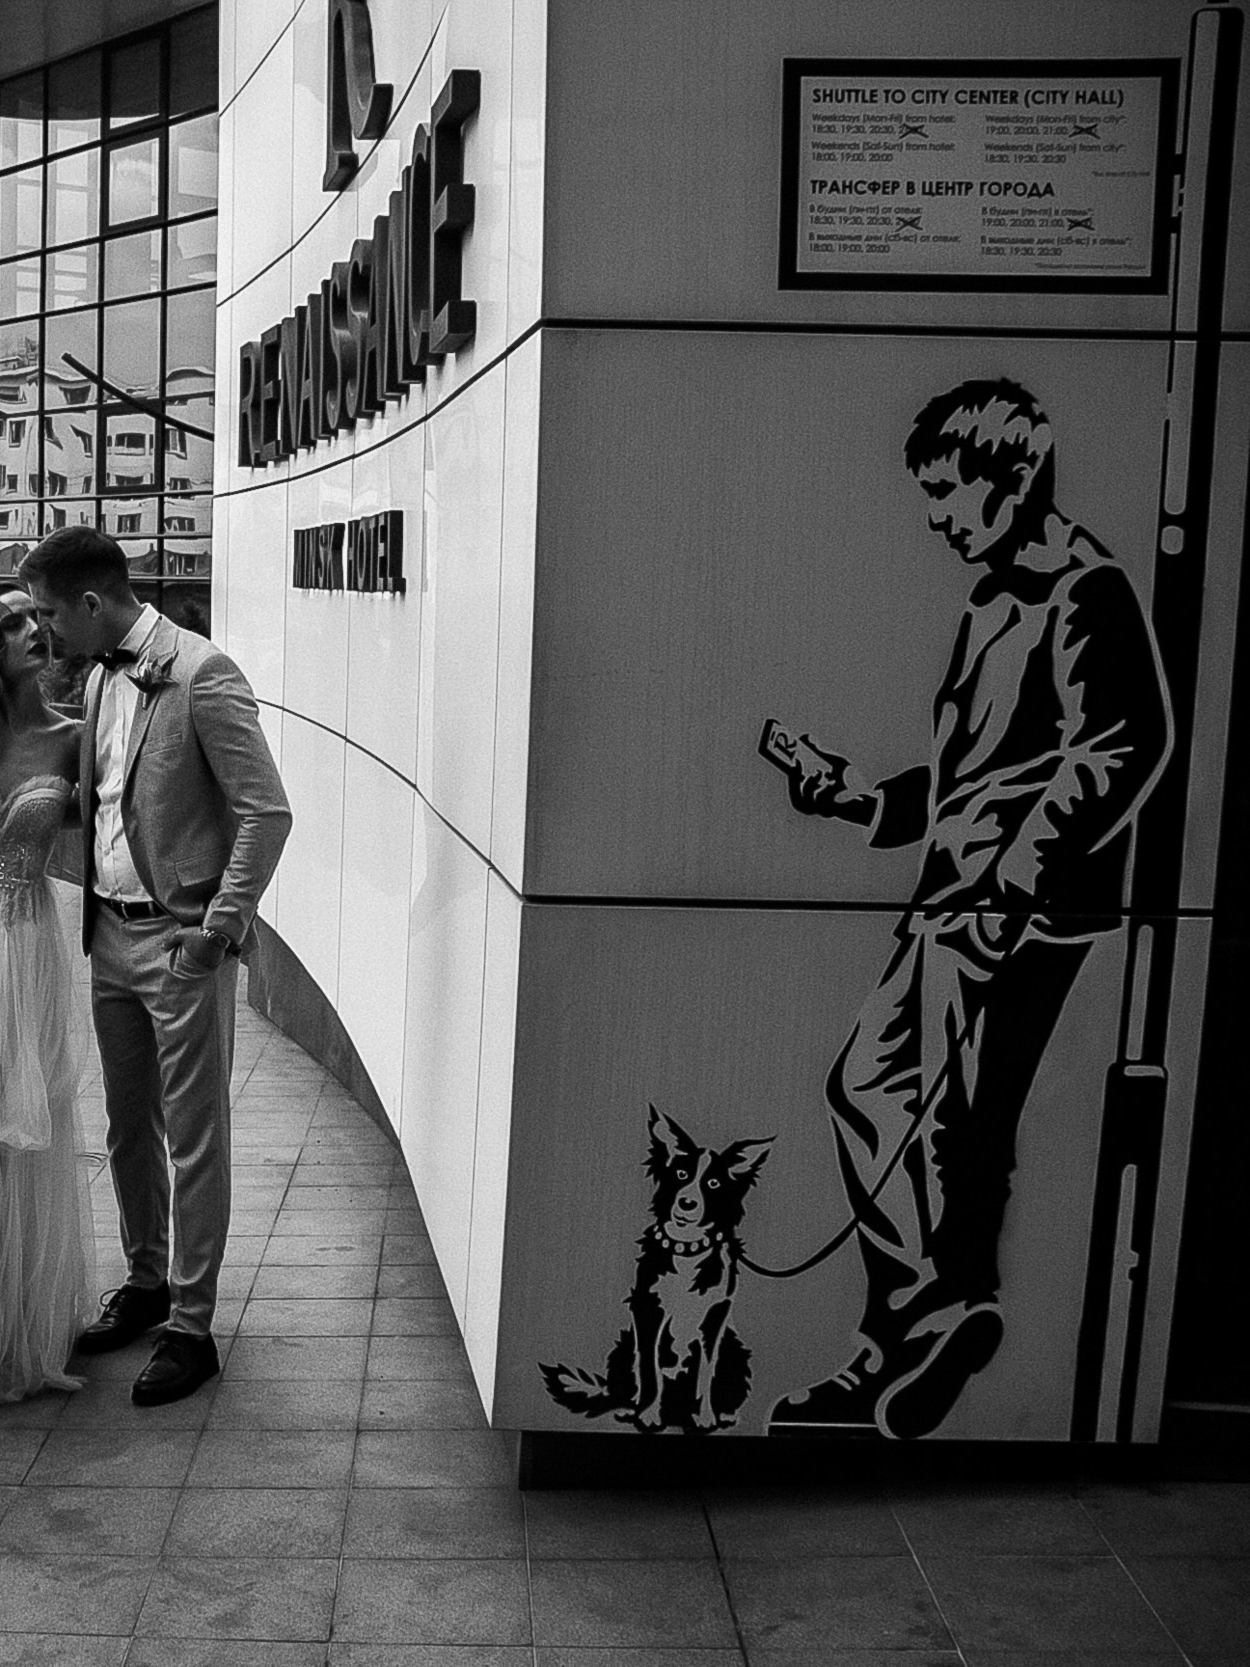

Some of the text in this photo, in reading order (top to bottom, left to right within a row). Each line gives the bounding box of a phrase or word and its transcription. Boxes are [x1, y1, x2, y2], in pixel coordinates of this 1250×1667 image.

[812, 89, 1124, 108] SHUTTLE TO CITY CENTER (CITY HALL)
[812, 114, 860, 123] Weekdays
[985, 115, 1033, 124] Weekdays
[812, 142, 860, 150] Weekends
[984, 143, 1033, 152] Weekends
[869, 153, 893, 162] 20:00
[1042, 155, 1066, 163] 20:30
[810, 180, 1055, 199] ТРАНСФЕР В ЦЕНТР ГОРОДА
[866, 244, 890, 253] 20:00
[1038, 248, 1062, 256] 20:30
[347, 510, 406, 593] HOTEL
